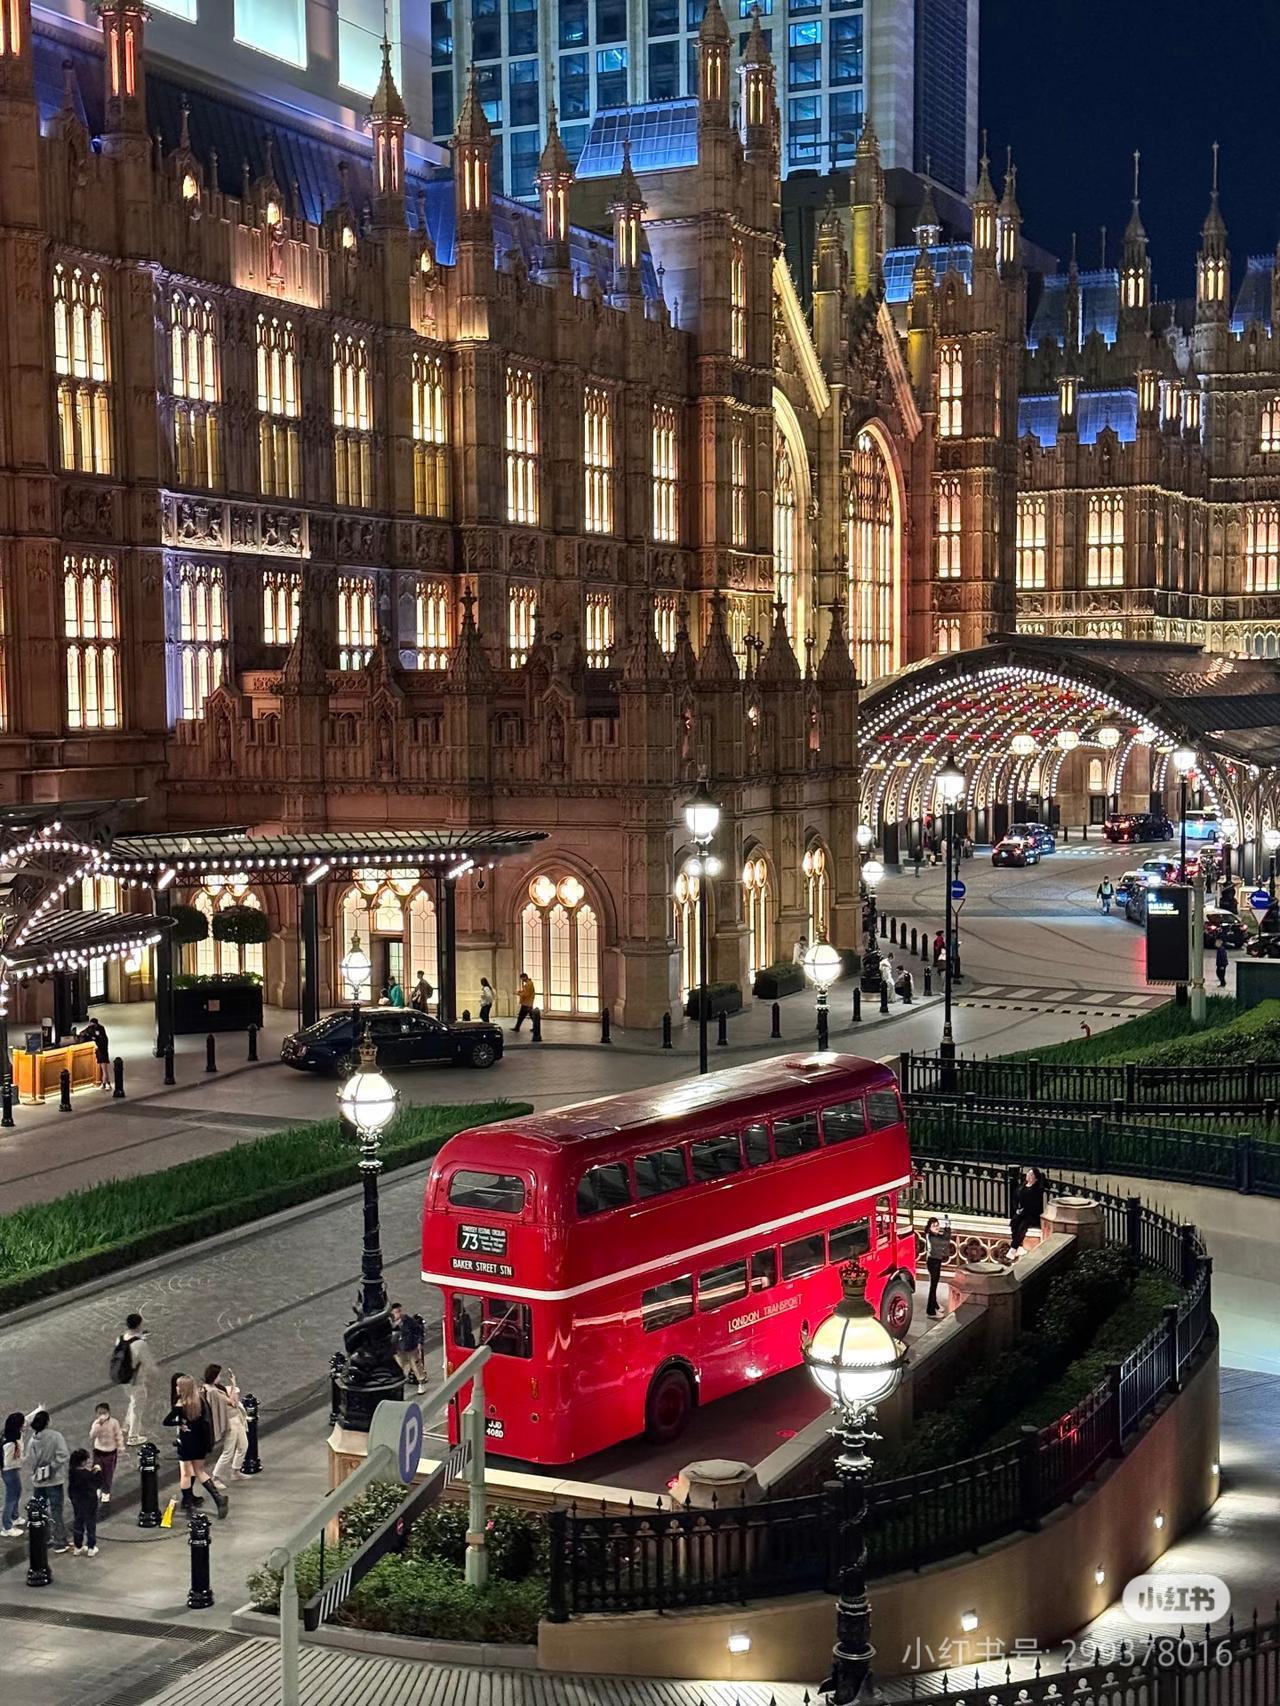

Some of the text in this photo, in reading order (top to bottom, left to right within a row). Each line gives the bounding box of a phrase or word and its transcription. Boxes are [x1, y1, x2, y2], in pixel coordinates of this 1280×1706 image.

[462, 1232, 478, 1250] 73
[453, 1259, 512, 1275] BAKER STREET STN
[728, 1294, 803, 1333] LONDON TRANSPORT
[406, 1417, 419, 1473] P
